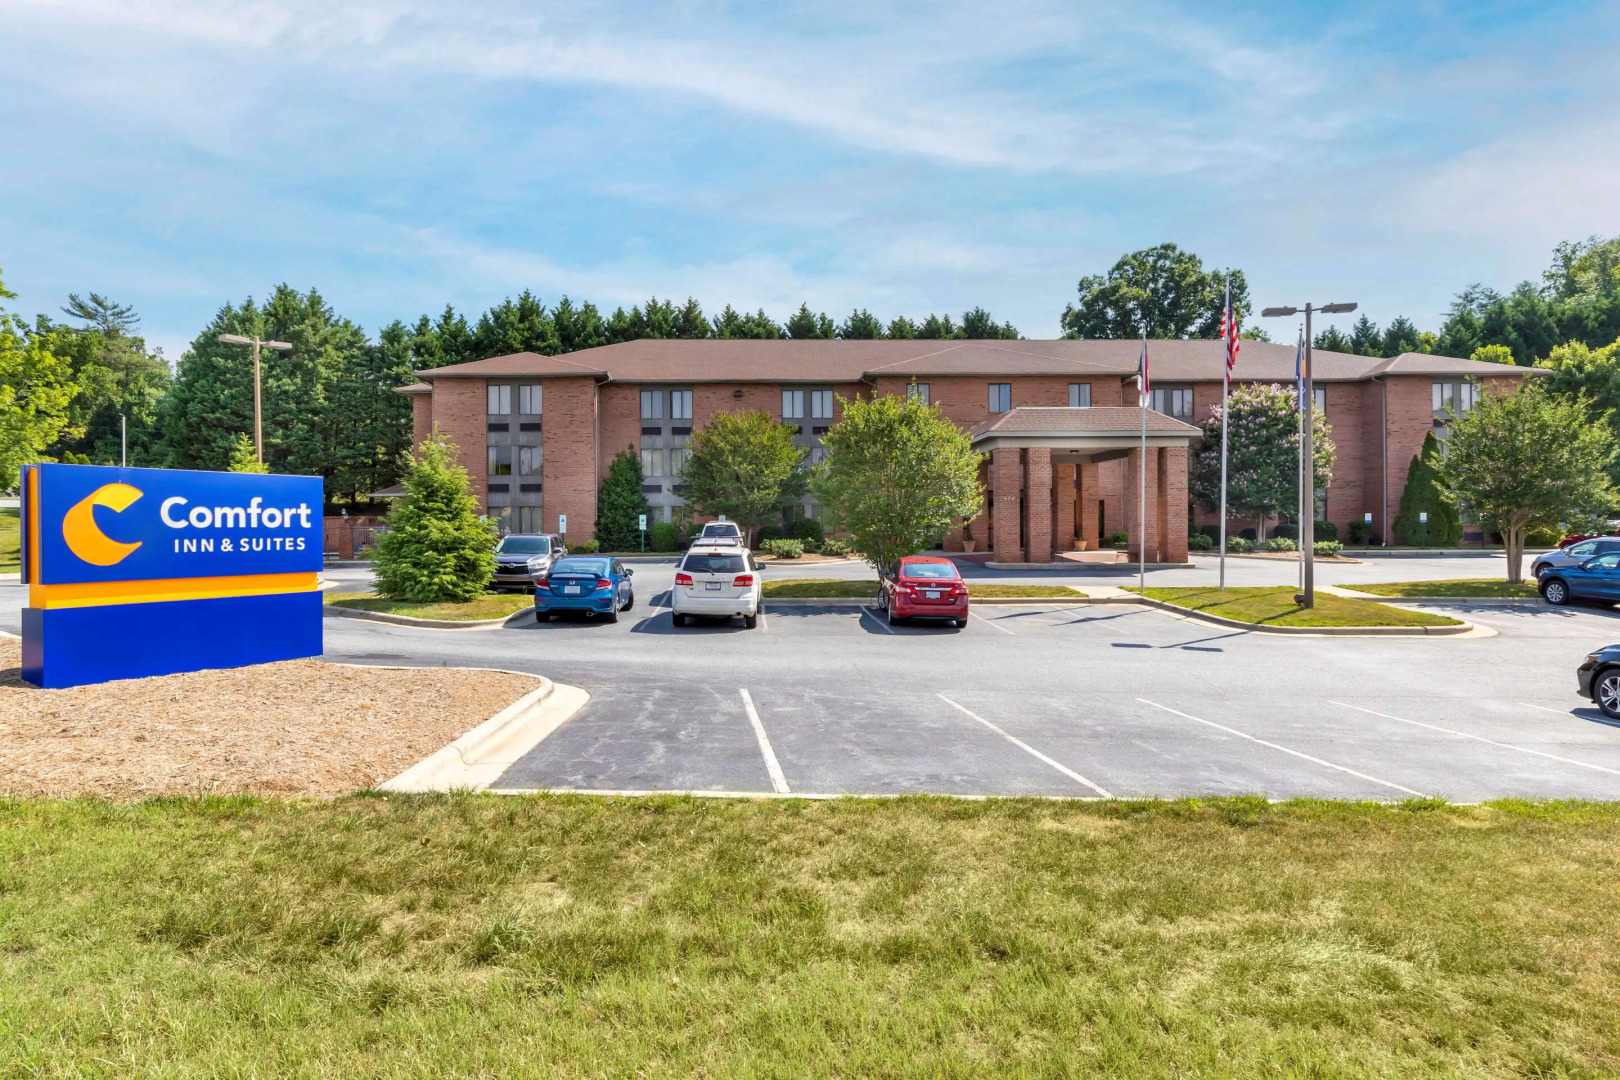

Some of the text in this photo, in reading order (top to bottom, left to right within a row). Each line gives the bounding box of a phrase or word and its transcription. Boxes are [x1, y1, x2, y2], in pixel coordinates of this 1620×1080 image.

[160, 496, 312, 529] Comfort
[174, 537, 306, 553] INN & SUITES
